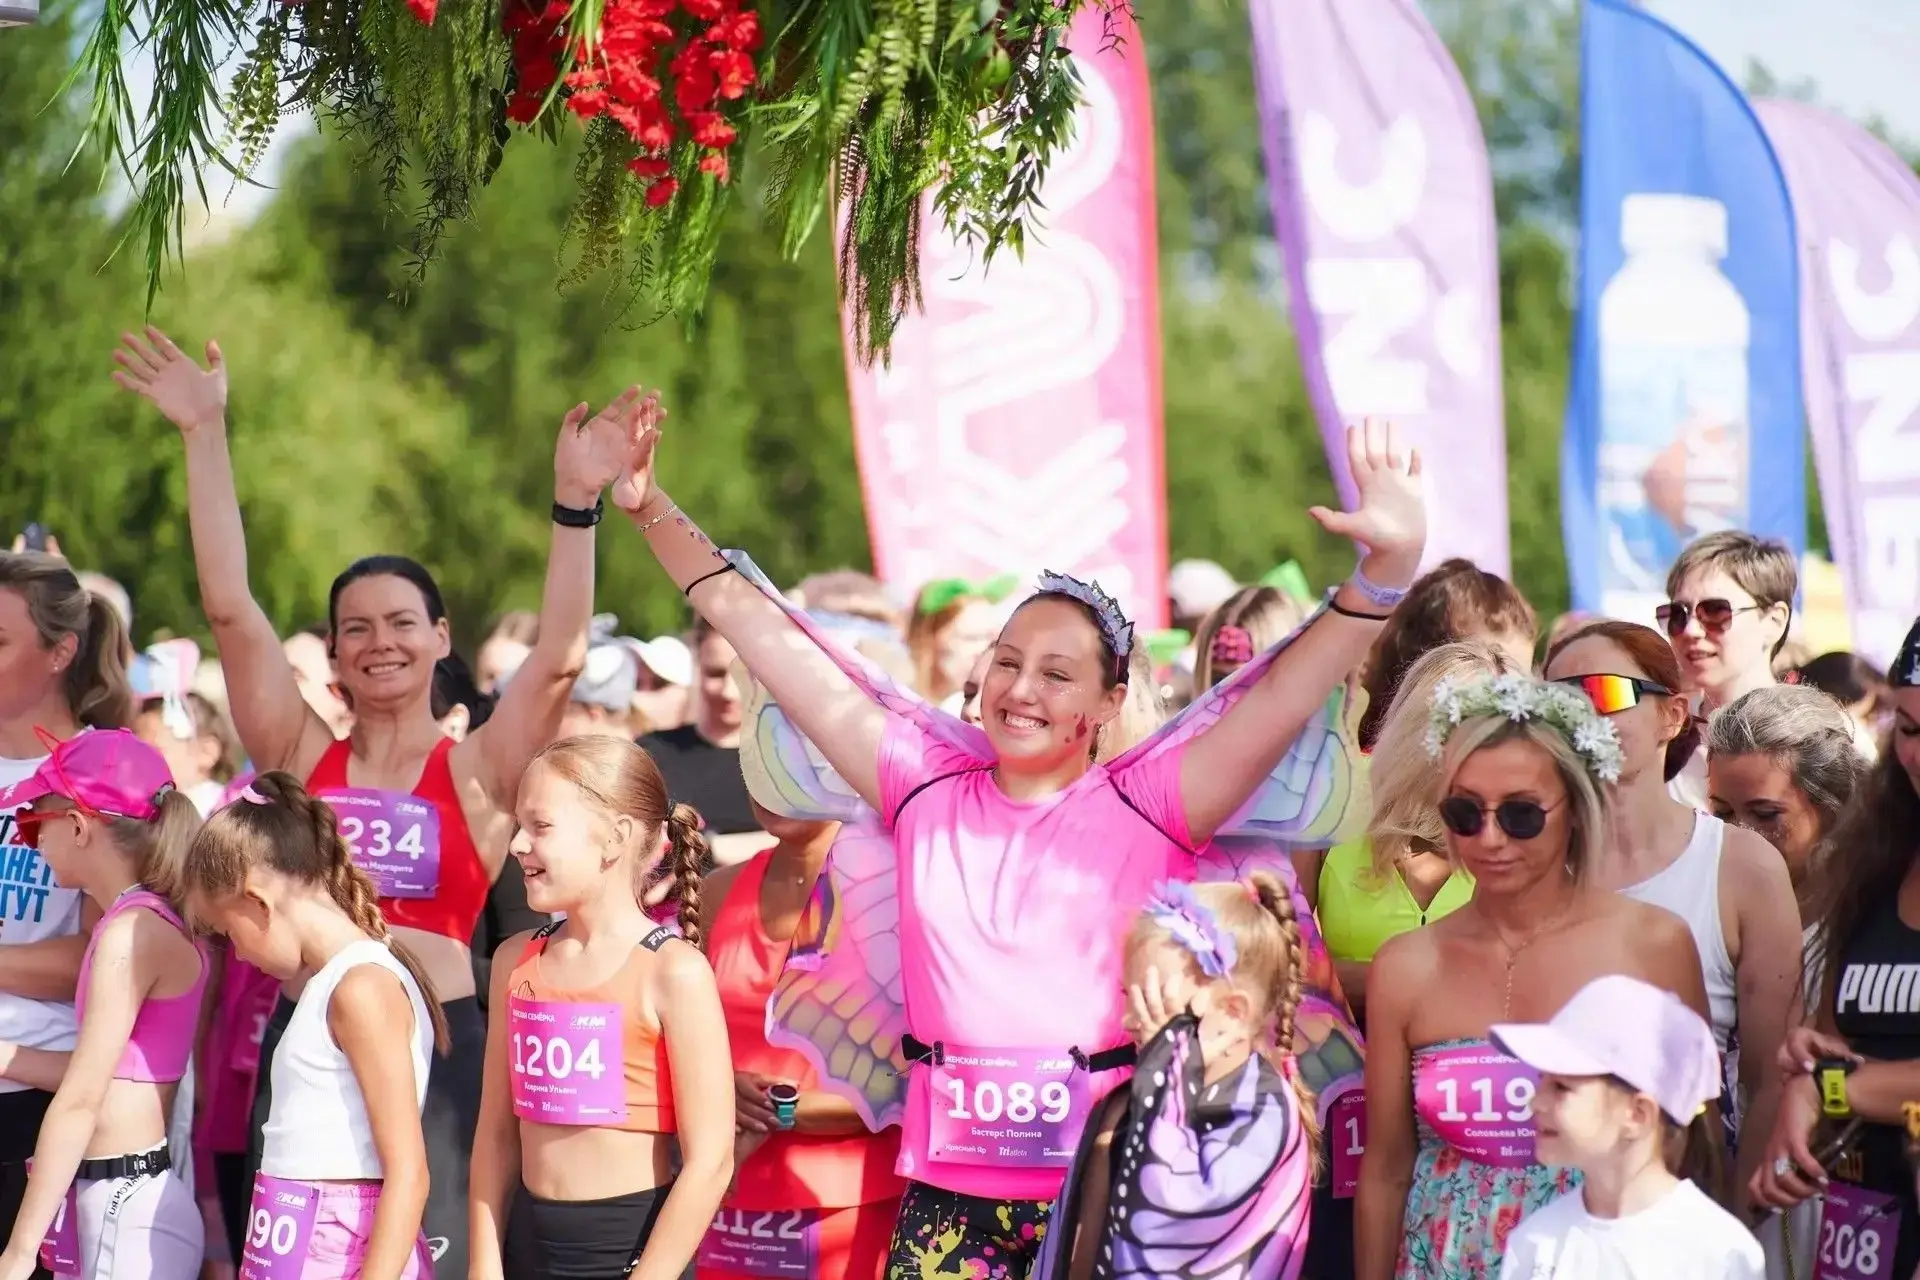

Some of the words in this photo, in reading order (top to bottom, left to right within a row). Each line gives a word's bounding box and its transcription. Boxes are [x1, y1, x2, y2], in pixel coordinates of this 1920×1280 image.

[341, 816, 425, 860] 234
[513, 1032, 606, 1080] 1204
[944, 1054, 979, 1066] ЖЕНСКАЯ
[947, 1078, 1071, 1123] 1089
[1436, 1077, 1536, 1121] 119
[971, 1126, 1004, 1139] Бастерс
[1006, 1128, 1042, 1138] Полина
[976, 1145, 987, 1155] Яр
[711, 1208, 803, 1239] 1122
